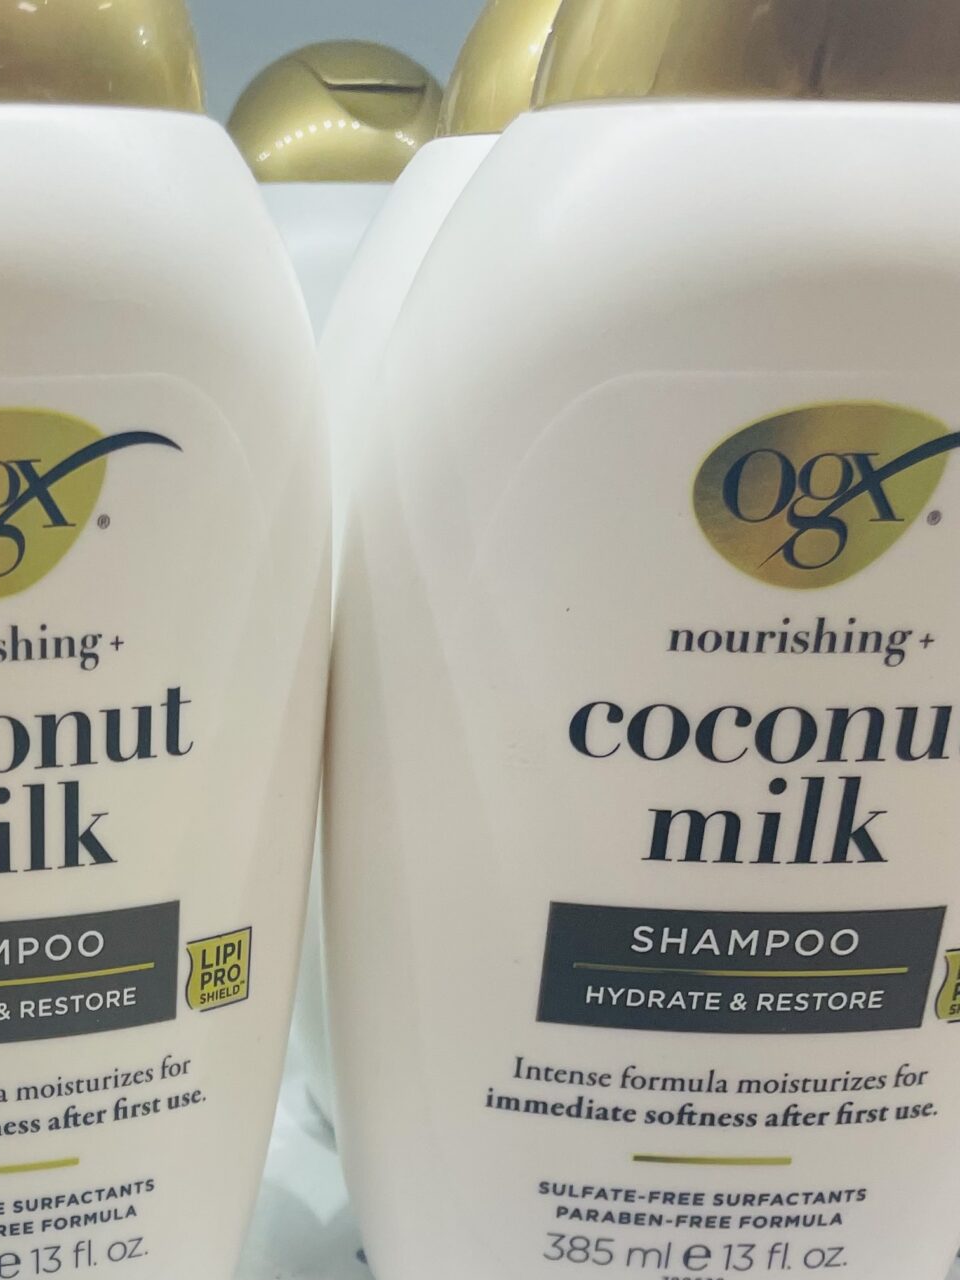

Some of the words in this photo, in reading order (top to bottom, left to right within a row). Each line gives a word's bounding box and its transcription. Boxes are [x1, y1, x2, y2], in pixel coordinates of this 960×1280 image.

[568, 700, 960, 764] coconu
[641, 776, 889, 865] milk
[201, 940, 242, 970] LIPI
[630, 925, 860, 957] SHAMPOO
[200, 964, 241, 990] PRO
[19, 986, 137, 1019] RESTORE
[585, 985, 721, 1011] HYDRATE
[729, 992, 747, 1011] &
[756, 989, 885, 1012] RESTORE
[16, 1066, 154, 1103] moisturizes
[160, 1055, 191, 1081] for
[512, 1056, 612, 1088] Intense
[620, 1065, 728, 1094] formula
[736, 1068, 886, 1095] moisturizes
[893, 1063, 928, 1089] for
[47, 1101, 107, 1131] after
[113, 1094, 162, 1121] first
[166, 1087, 207, 1111] use.
[485, 1088, 637, 1123] immediate
[644, 1102, 758, 1128] softness
[764, 1103, 830, 1128] after
[835, 1101, 887, 1126] first
[895, 1102, 938, 1121] use.
[12, 1179, 155, 1214] SURFACTANTS
[538, 1180, 705, 1206] SULFATE-FREE
[712, 1188, 867, 1208] SURFACTANTS
[41, 1204, 138, 1232] FORMULA
[556, 1205, 731, 1229] PARABEN-FREE
[738, 1213, 843, 1230] FORMULA
[31, 1246, 62, 1274] 13
[73, 1239, 98, 1267] fl.
[107, 1236, 149, 1262] oz.
[543, 1231, 615, 1266] 385
[626, 1241, 672, 1269] ml
[722, 1244, 754, 1271] 13
[767, 1242, 792, 1270] fl.
[803, 1246, 847, 1269] oz.
